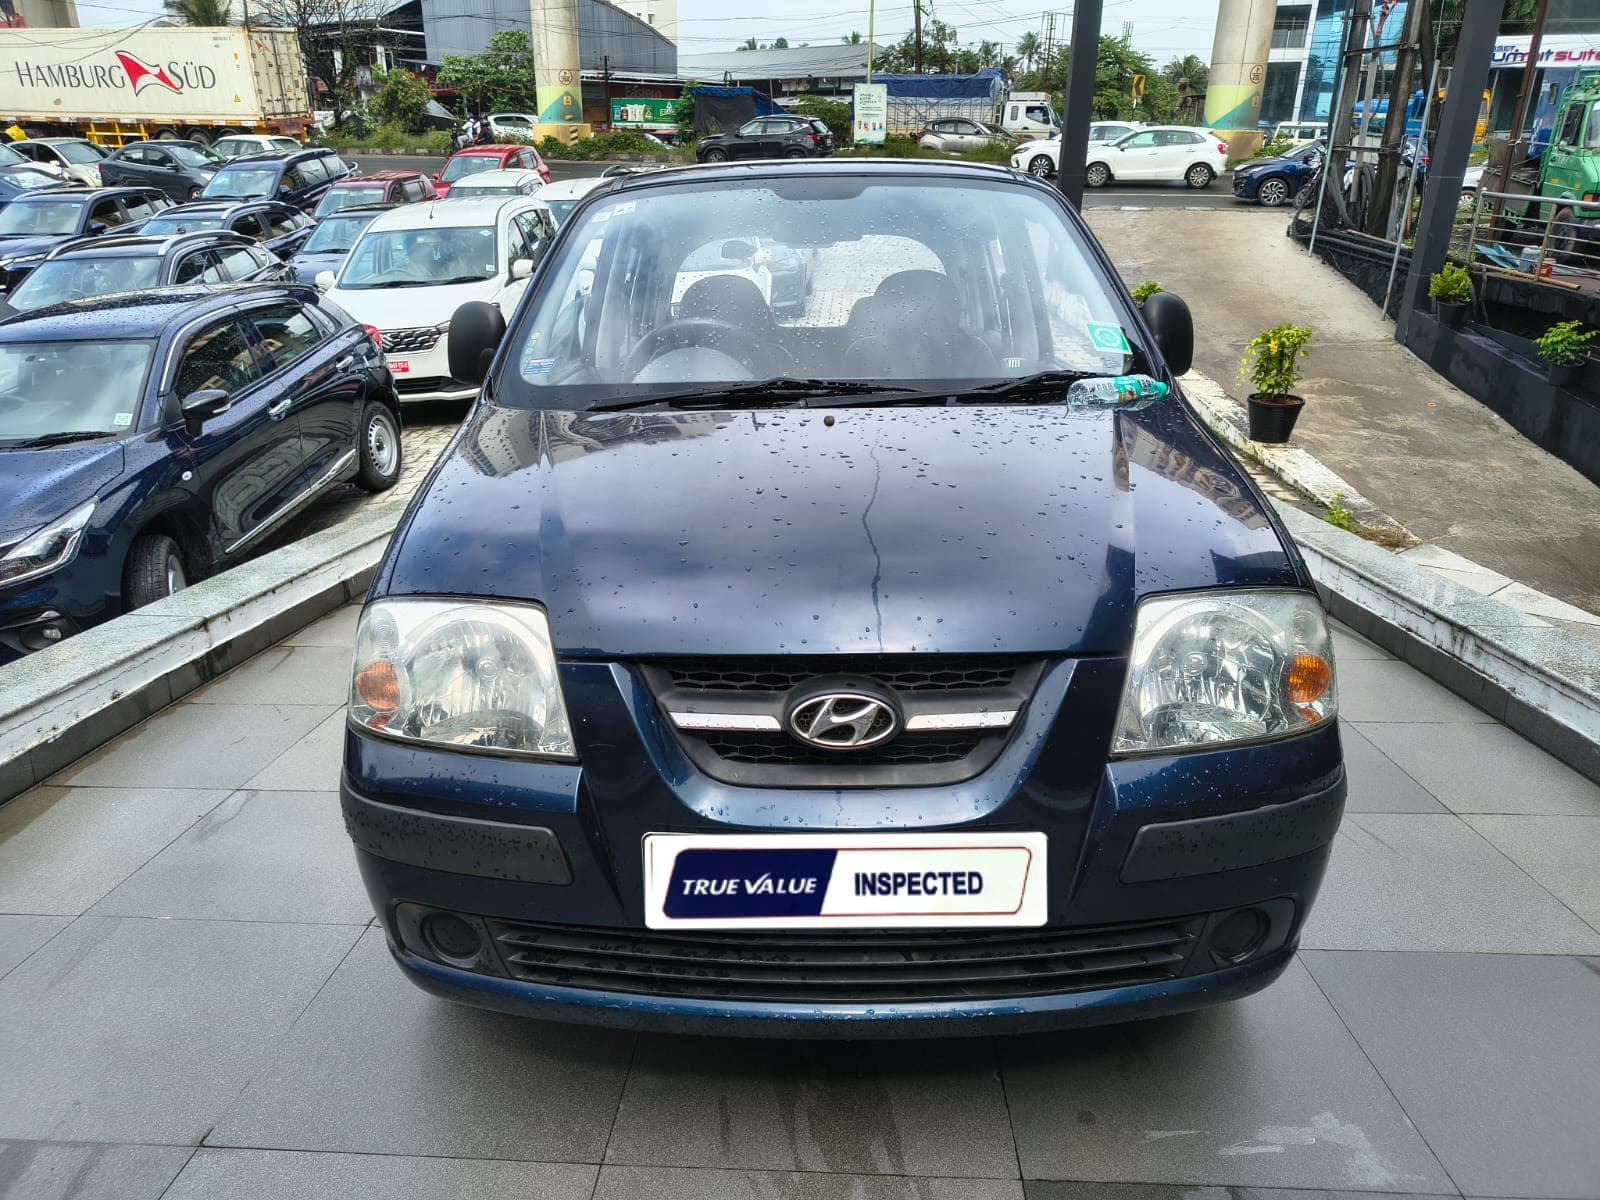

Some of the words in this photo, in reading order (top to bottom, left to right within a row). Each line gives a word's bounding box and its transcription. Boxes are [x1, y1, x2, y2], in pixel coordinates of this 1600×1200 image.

[15, 61, 125, 88] HAMBURG
[168, 61, 216, 89] SÜD
[624, 86, 662, 98] Eastern
[682, 878, 740, 896] TRUE
[744, 872, 817, 895] VALUE
[854, 871, 983, 896] INSPECTED
